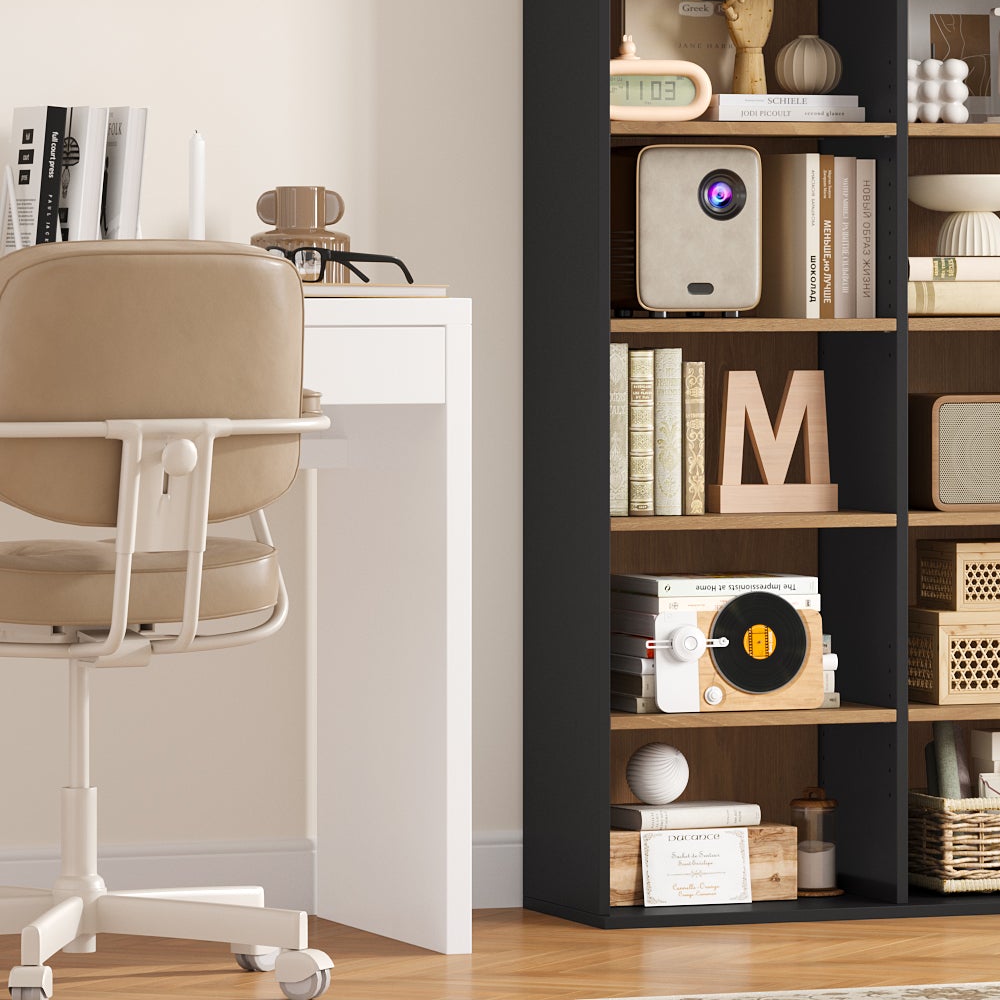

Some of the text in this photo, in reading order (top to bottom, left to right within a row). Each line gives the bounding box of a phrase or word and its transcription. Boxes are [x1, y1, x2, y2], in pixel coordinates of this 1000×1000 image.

[682, 3, 709, 13] Greek
[767, 97, 808, 105] SCHIELE
[48, 131, 59, 178] full court press
[862, 180, 873, 298] НОВЫЙ ОБРАЗ ЖИЗНИ
[809, 255, 817, 303] ШОКОЛАД
[822, 273, 832, 303] ЛУЧШЕ
[695, 584, 717, 592] Home
[728, 582, 781, 591] Impressionists
